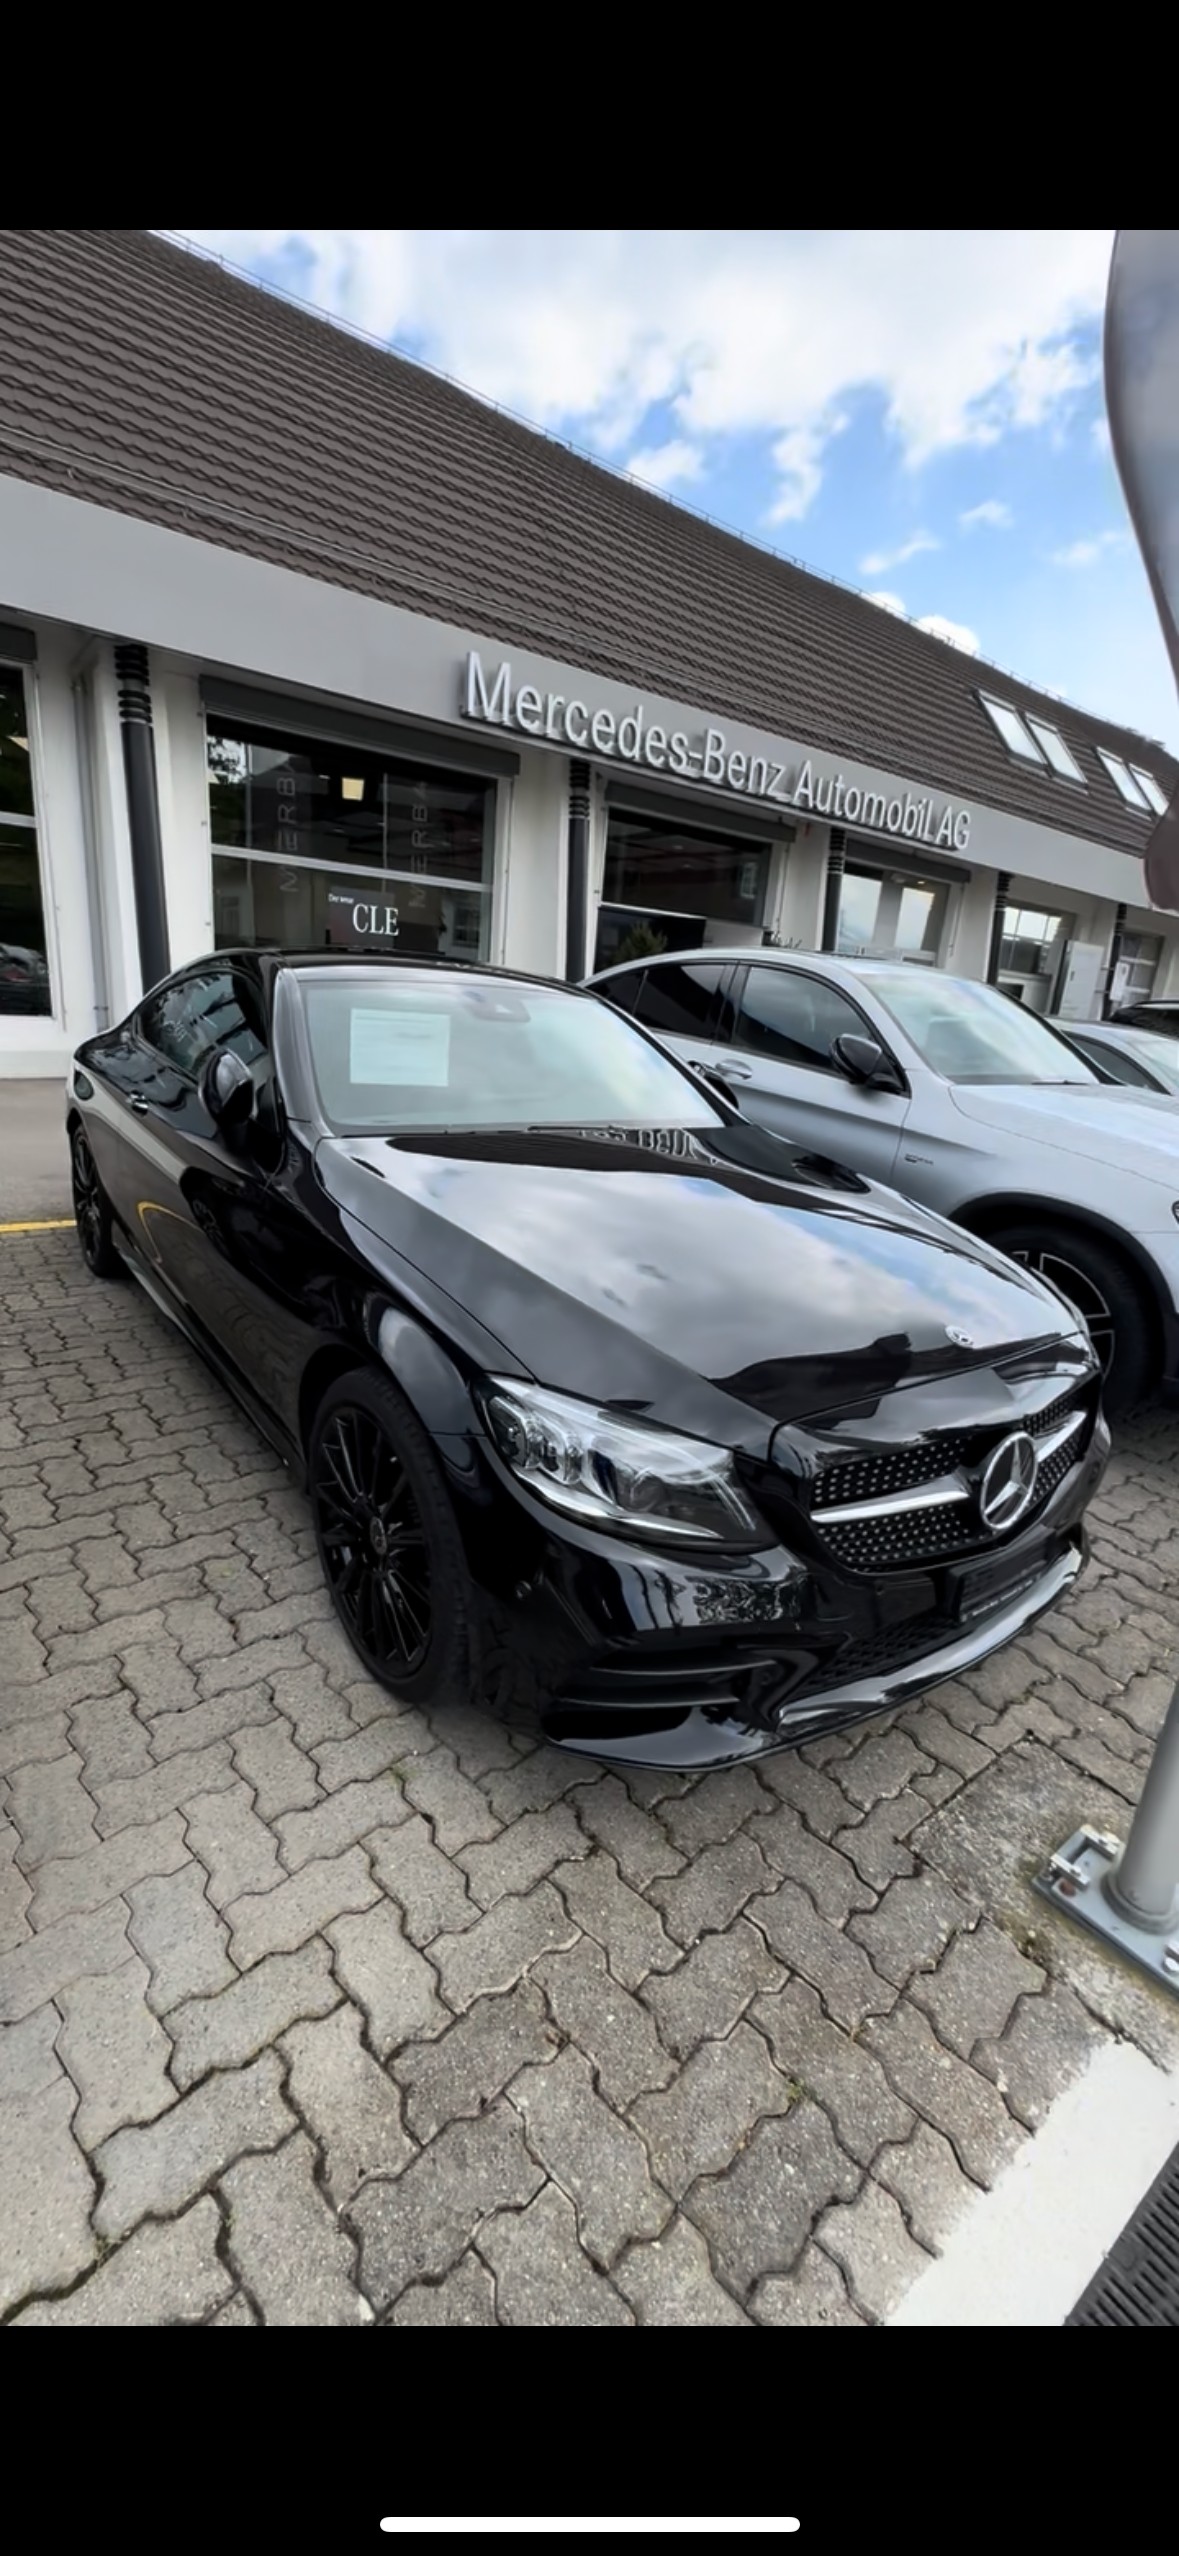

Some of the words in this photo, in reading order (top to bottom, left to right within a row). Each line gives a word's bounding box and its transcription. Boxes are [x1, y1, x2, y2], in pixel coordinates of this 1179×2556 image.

[467, 650, 788, 798] Mercedes-Benz
[791, 760, 934, 843] Automobil
[935, 807, 972, 850] AG
[352, 903, 400, 937] CLE
